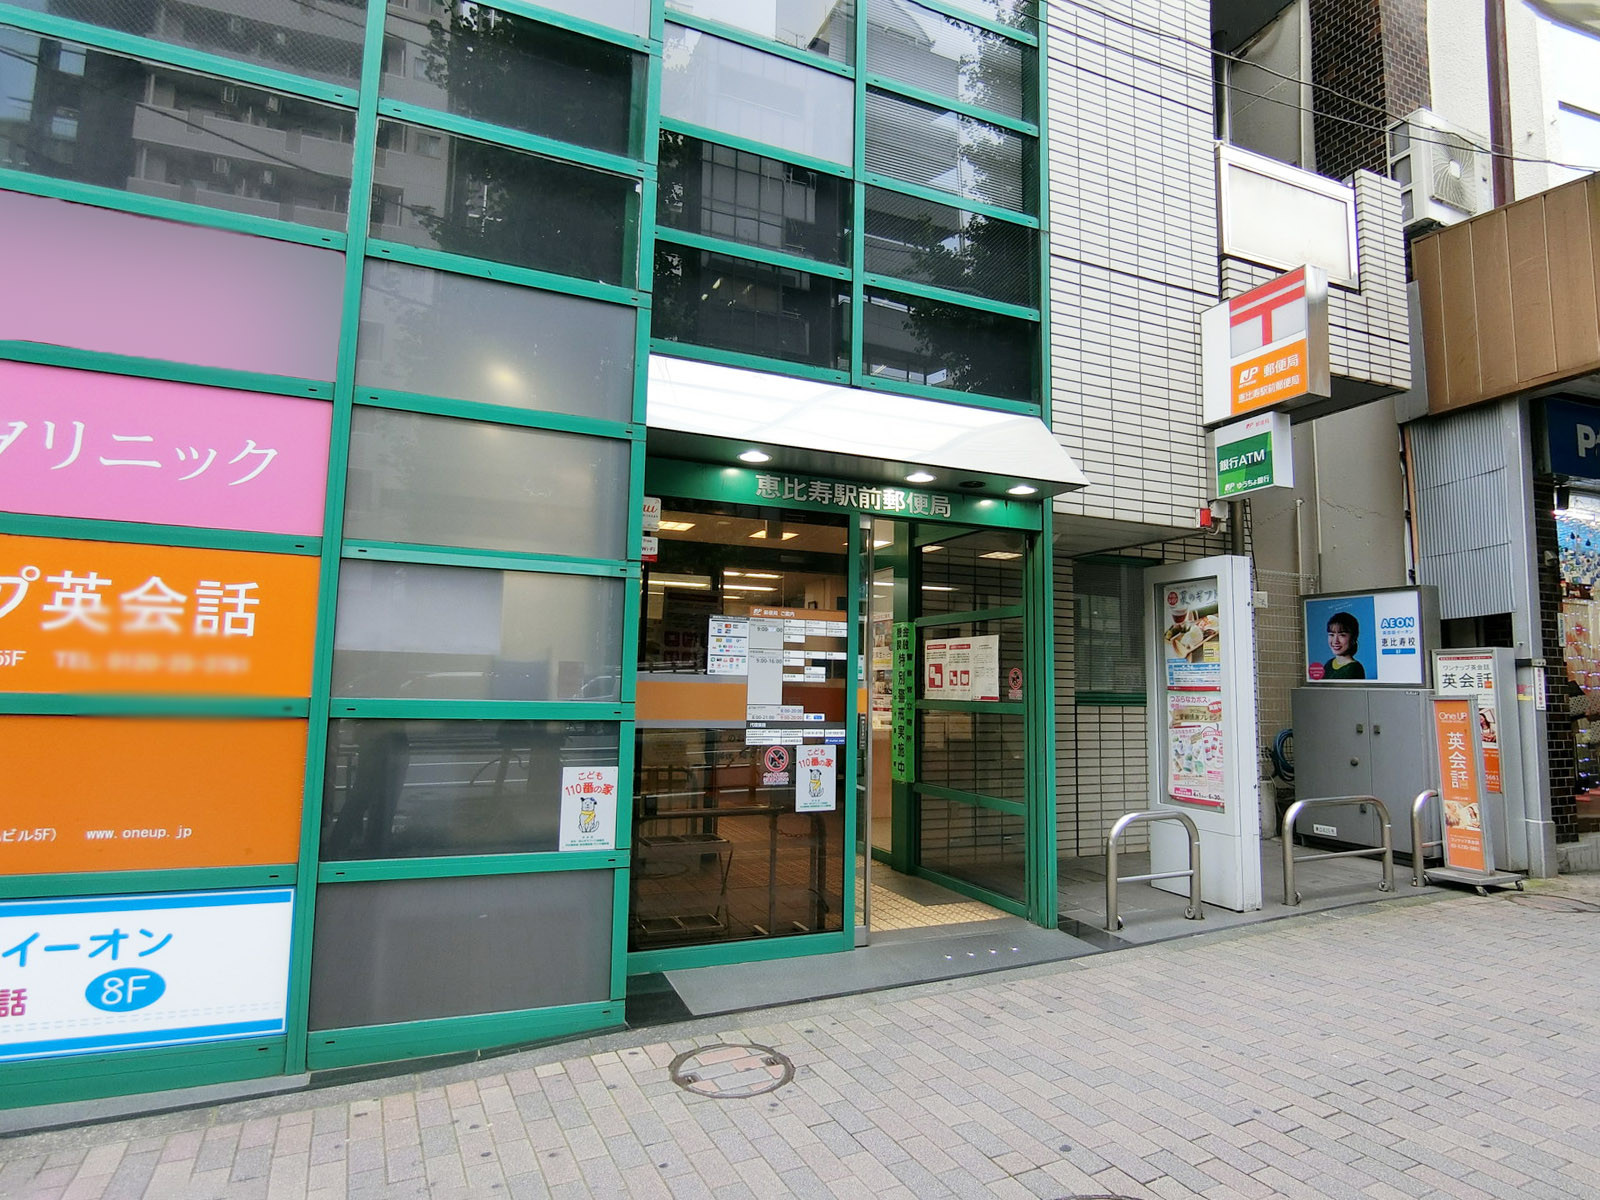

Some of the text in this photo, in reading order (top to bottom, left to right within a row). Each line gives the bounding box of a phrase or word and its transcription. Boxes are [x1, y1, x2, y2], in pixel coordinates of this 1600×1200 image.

[1263, 354, 1299, 378] 郵便局
[1238, 374, 1300, 404] 恵比寿駅前郵便局
[1219, 449, 1265, 472] 銀行ATM
[1236, 474, 1270, 490] ゆうちょ銀行
[755, 472, 952, 519] 恵比寿駅前郵便局
[1381, 616, 1415, 629] AEON
[1381, 637, 1416, 647] 恵比寿校
[1442, 672, 1493, 689] 英会話
[807, 748, 826, 756] こども
[1447, 731, 1469, 789] 英会話
[798, 756, 834, 769] 110番の家
[578, 771, 603, 781] こども
[565, 782, 614, 796] 110番の家
[2, 928, 173, 967] イーオン
[100, 974, 151, 1005] 8F
